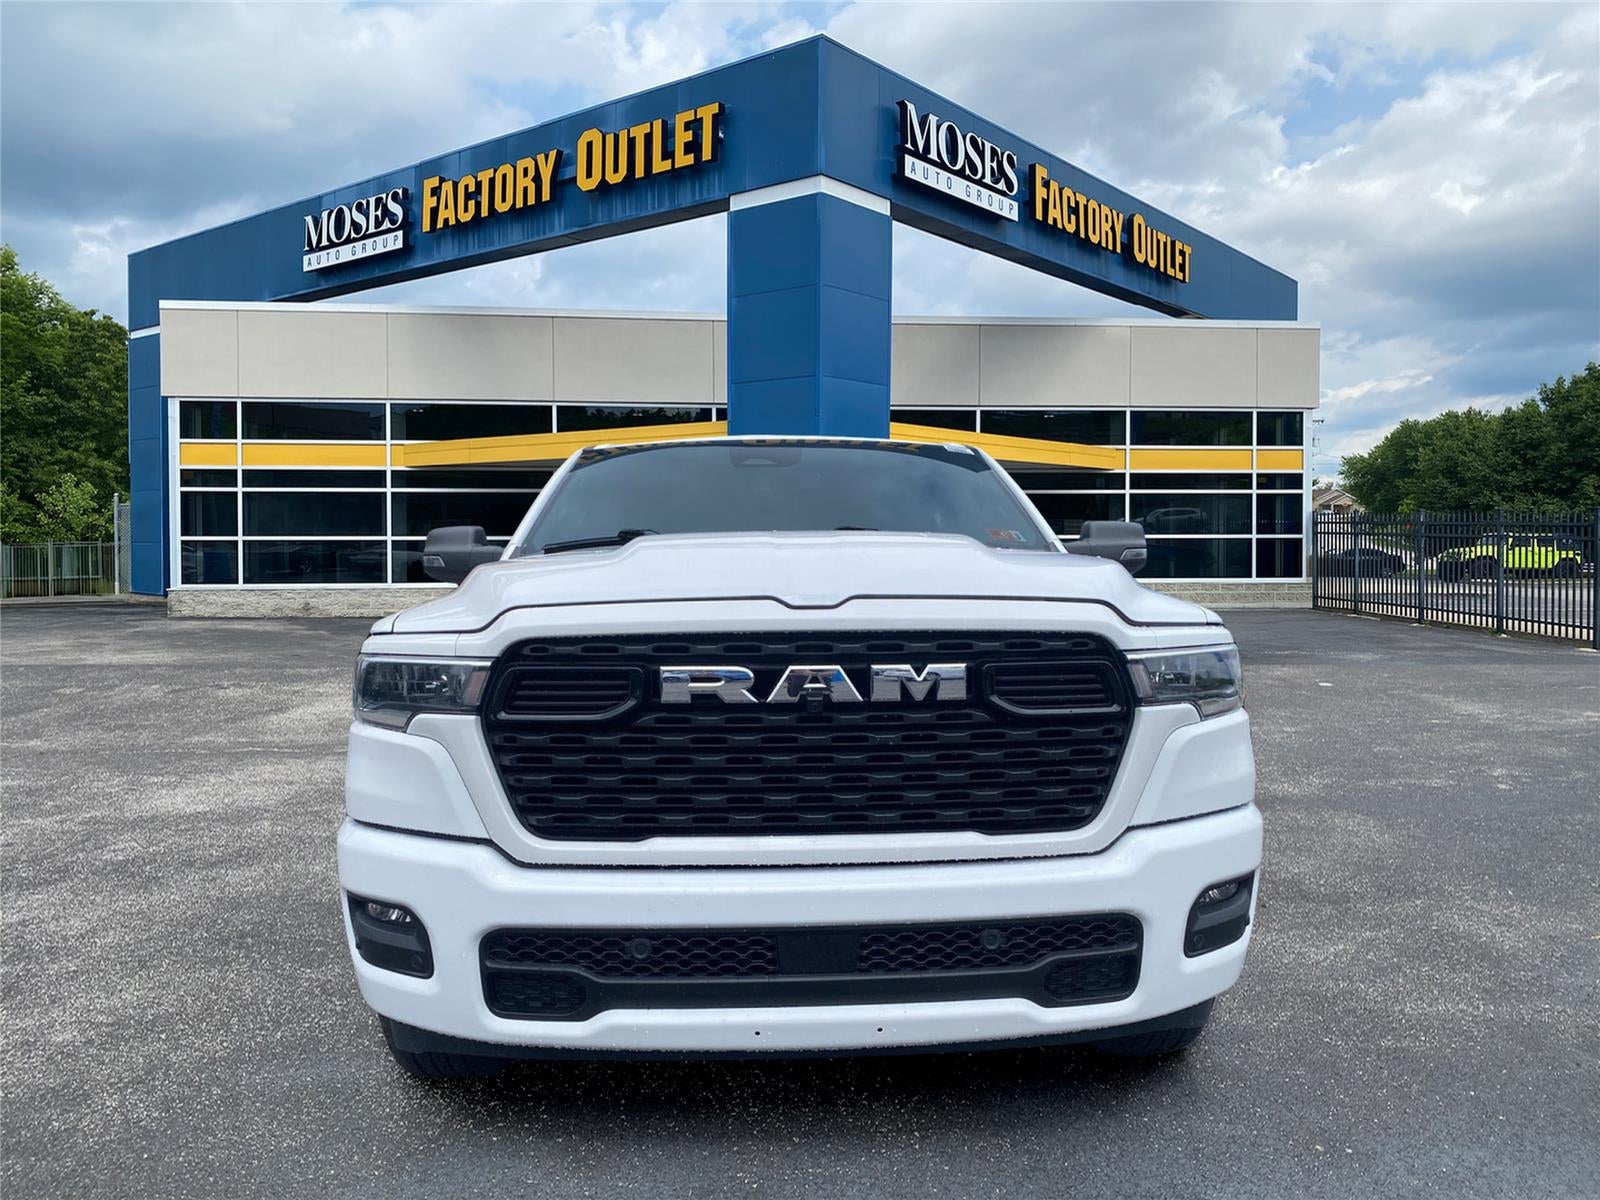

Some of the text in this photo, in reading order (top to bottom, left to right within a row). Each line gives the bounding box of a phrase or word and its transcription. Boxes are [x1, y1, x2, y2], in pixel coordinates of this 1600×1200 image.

[422, 103, 719, 232] FACTORY OUTLET
[904, 100, 1018, 195] MOSES
[909, 160, 1015, 216] AUTO GROUP
[304, 189, 403, 250] MOSES
[1035, 163, 1192, 283] FACTORY OUTLET
[306, 234, 400, 268] AUTO GROUP
[659, 663, 967, 704] RAM
